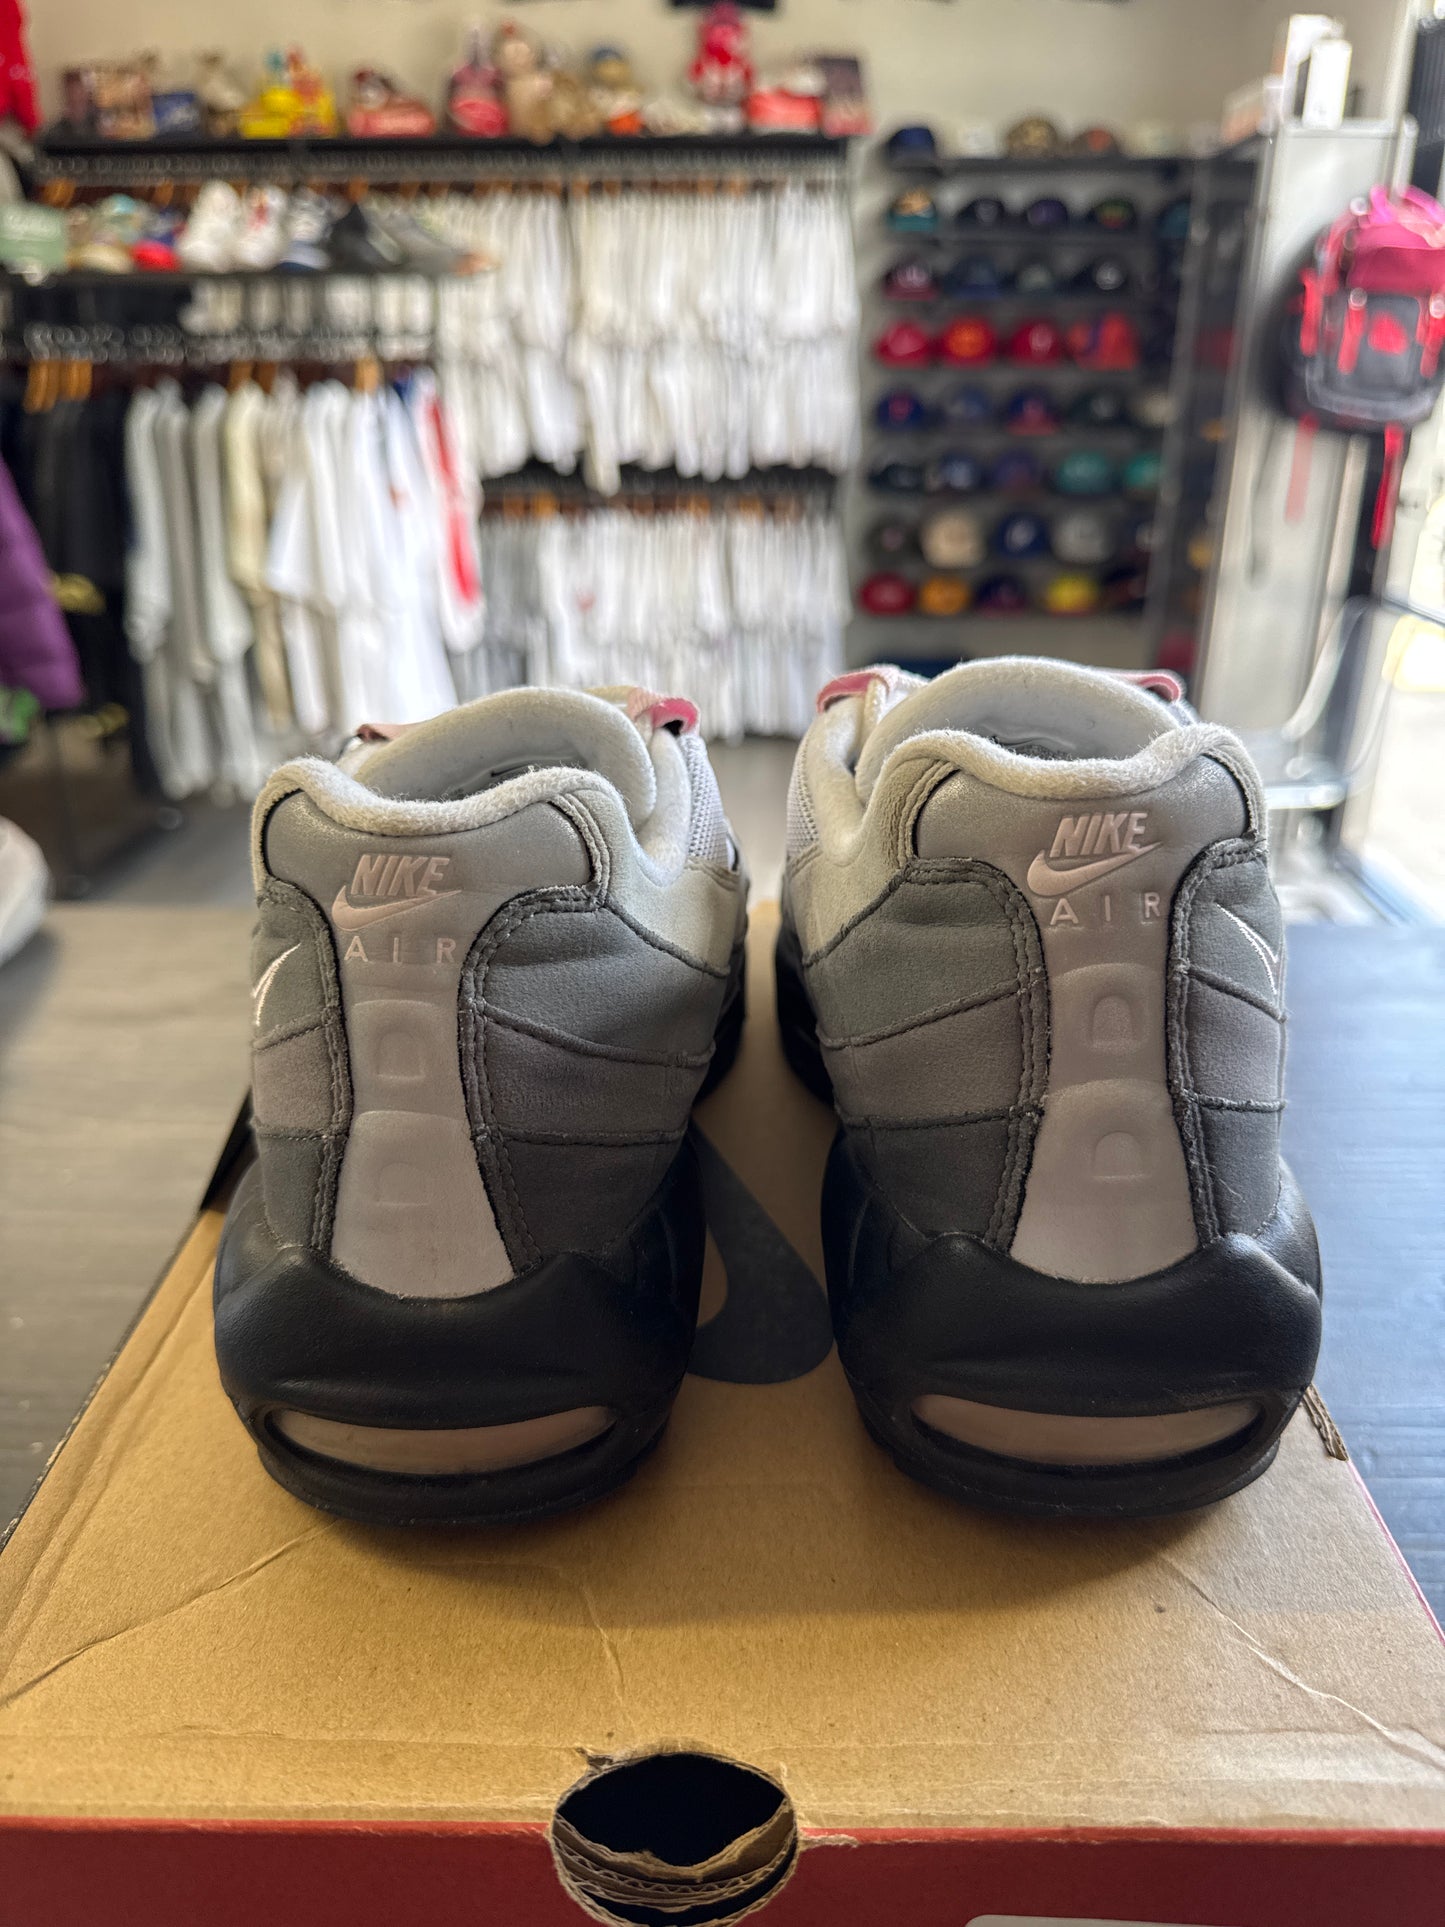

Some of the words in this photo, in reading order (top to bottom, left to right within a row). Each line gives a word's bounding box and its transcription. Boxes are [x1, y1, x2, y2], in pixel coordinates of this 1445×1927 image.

[1049, 812, 1148, 858] NIKE
[350, 854, 450, 897] NIKE
[1050, 891, 1161, 926] AIR
[343, 935, 456, 964] AIR
